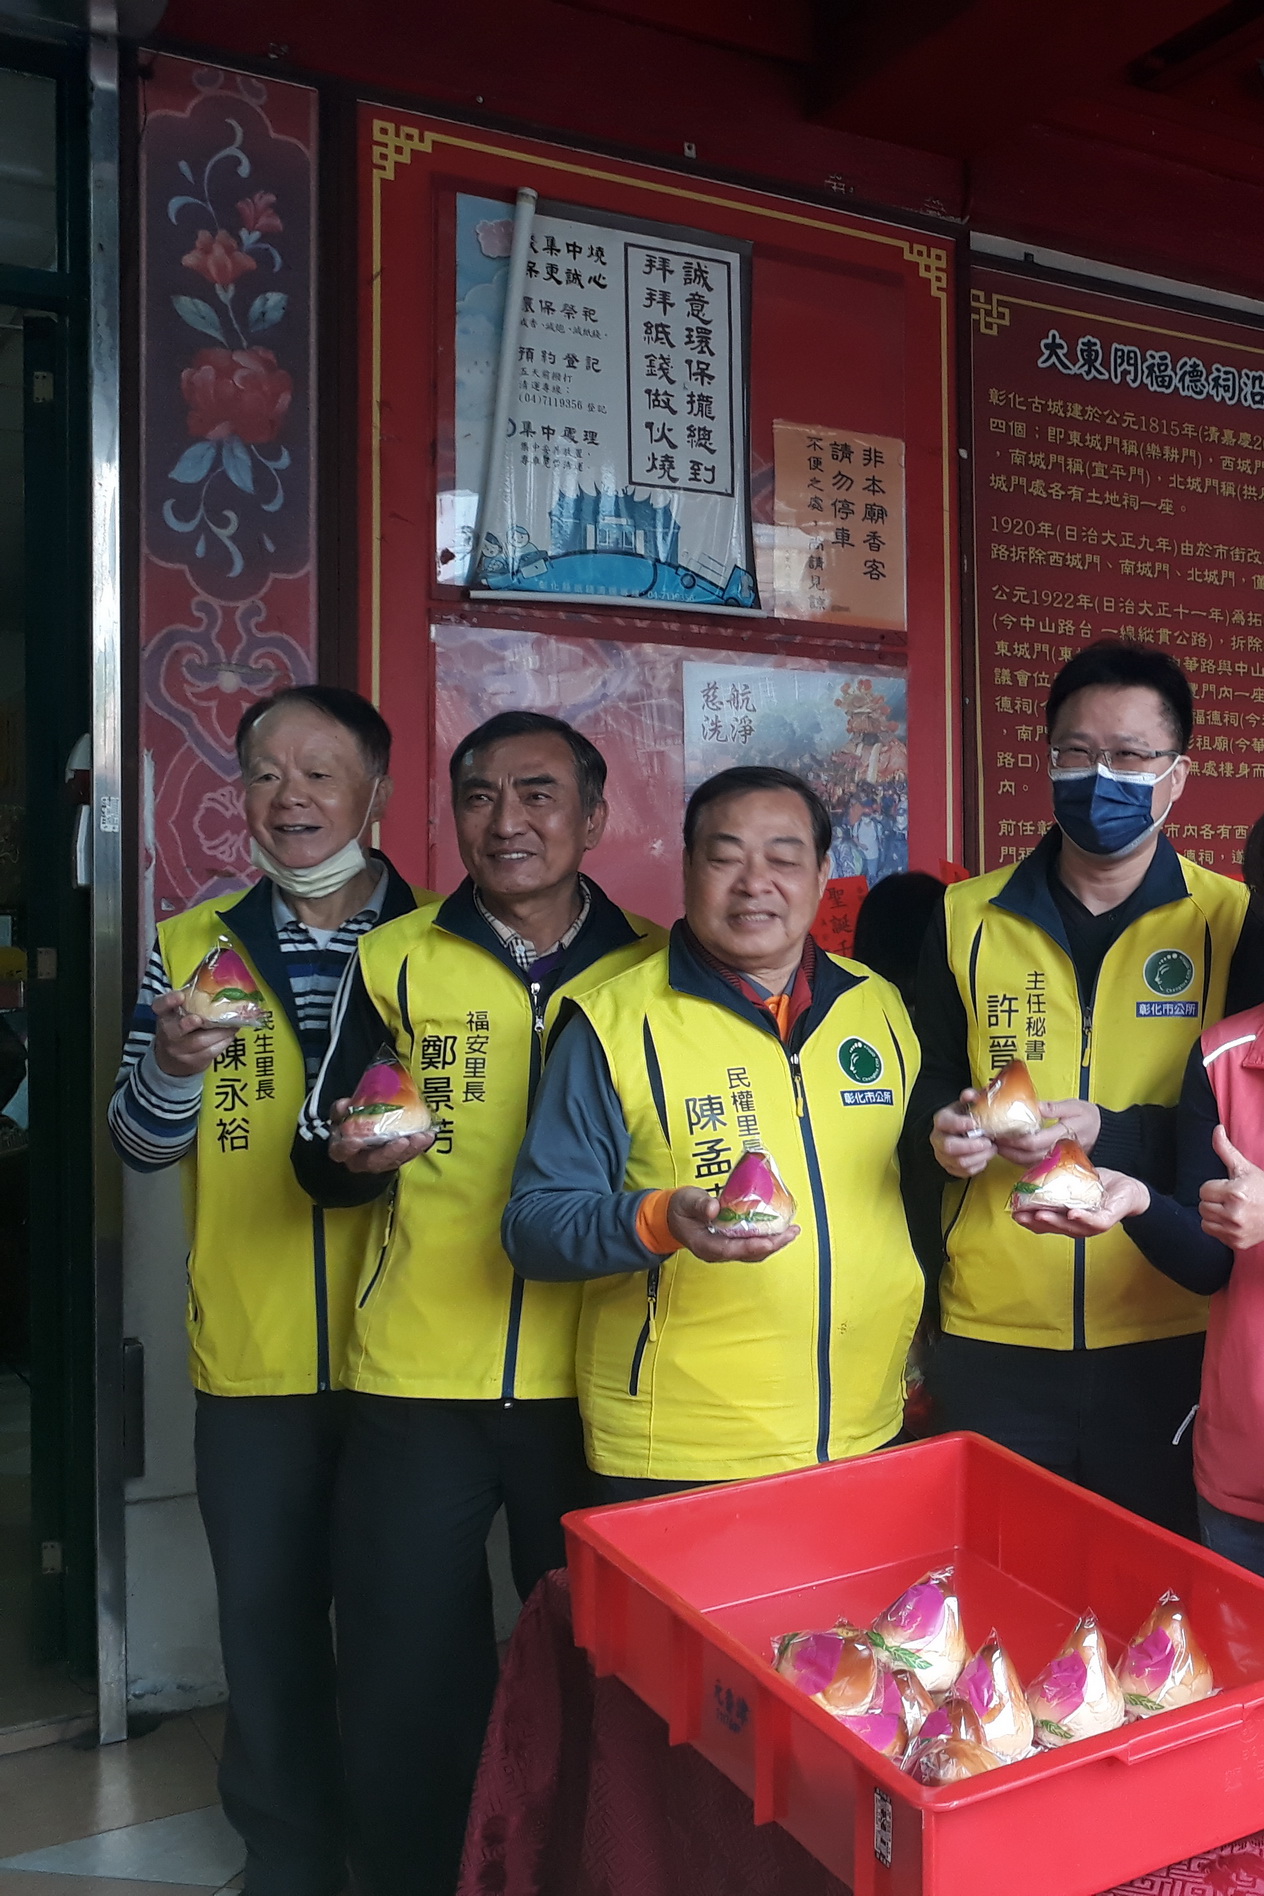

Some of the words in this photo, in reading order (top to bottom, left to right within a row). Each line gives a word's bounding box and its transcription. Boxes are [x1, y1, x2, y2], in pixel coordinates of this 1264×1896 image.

[518, 346, 602, 373] 預約登記
[642, 254, 680, 484] 拜拜紙錢做伙燒
[682, 261, 717, 486] 誠意環保攏總到
[518, 392, 583, 410] (04)7119356
[519, 420, 600, 446] 集中處理
[829, 441, 855, 549] 請勿停車
[861, 446, 888, 581] 非本廟香客
[993, 668, 1058, 689] 議會位
[994, 640, 1082, 664] 東城門(東
[700, 680, 757, 713] 慈航
[701, 714, 756, 745] 洗淨
[1160, 823, 1254, 840] 市內各有西
[986, 993, 1019, 1083] 許晉
[1025, 970, 1047, 1061] 主任秘書
[1138, 1003, 1196, 1016] 彰化市公所
[253, 1010, 275, 1101] 民生里長
[462, 1010, 490, 1103] 福安里長
[213, 1038, 250, 1152] 陳永裕
[843, 1091, 892, 1104] 彰化市公所
[685, 1094, 733, 1198] 陳孟
